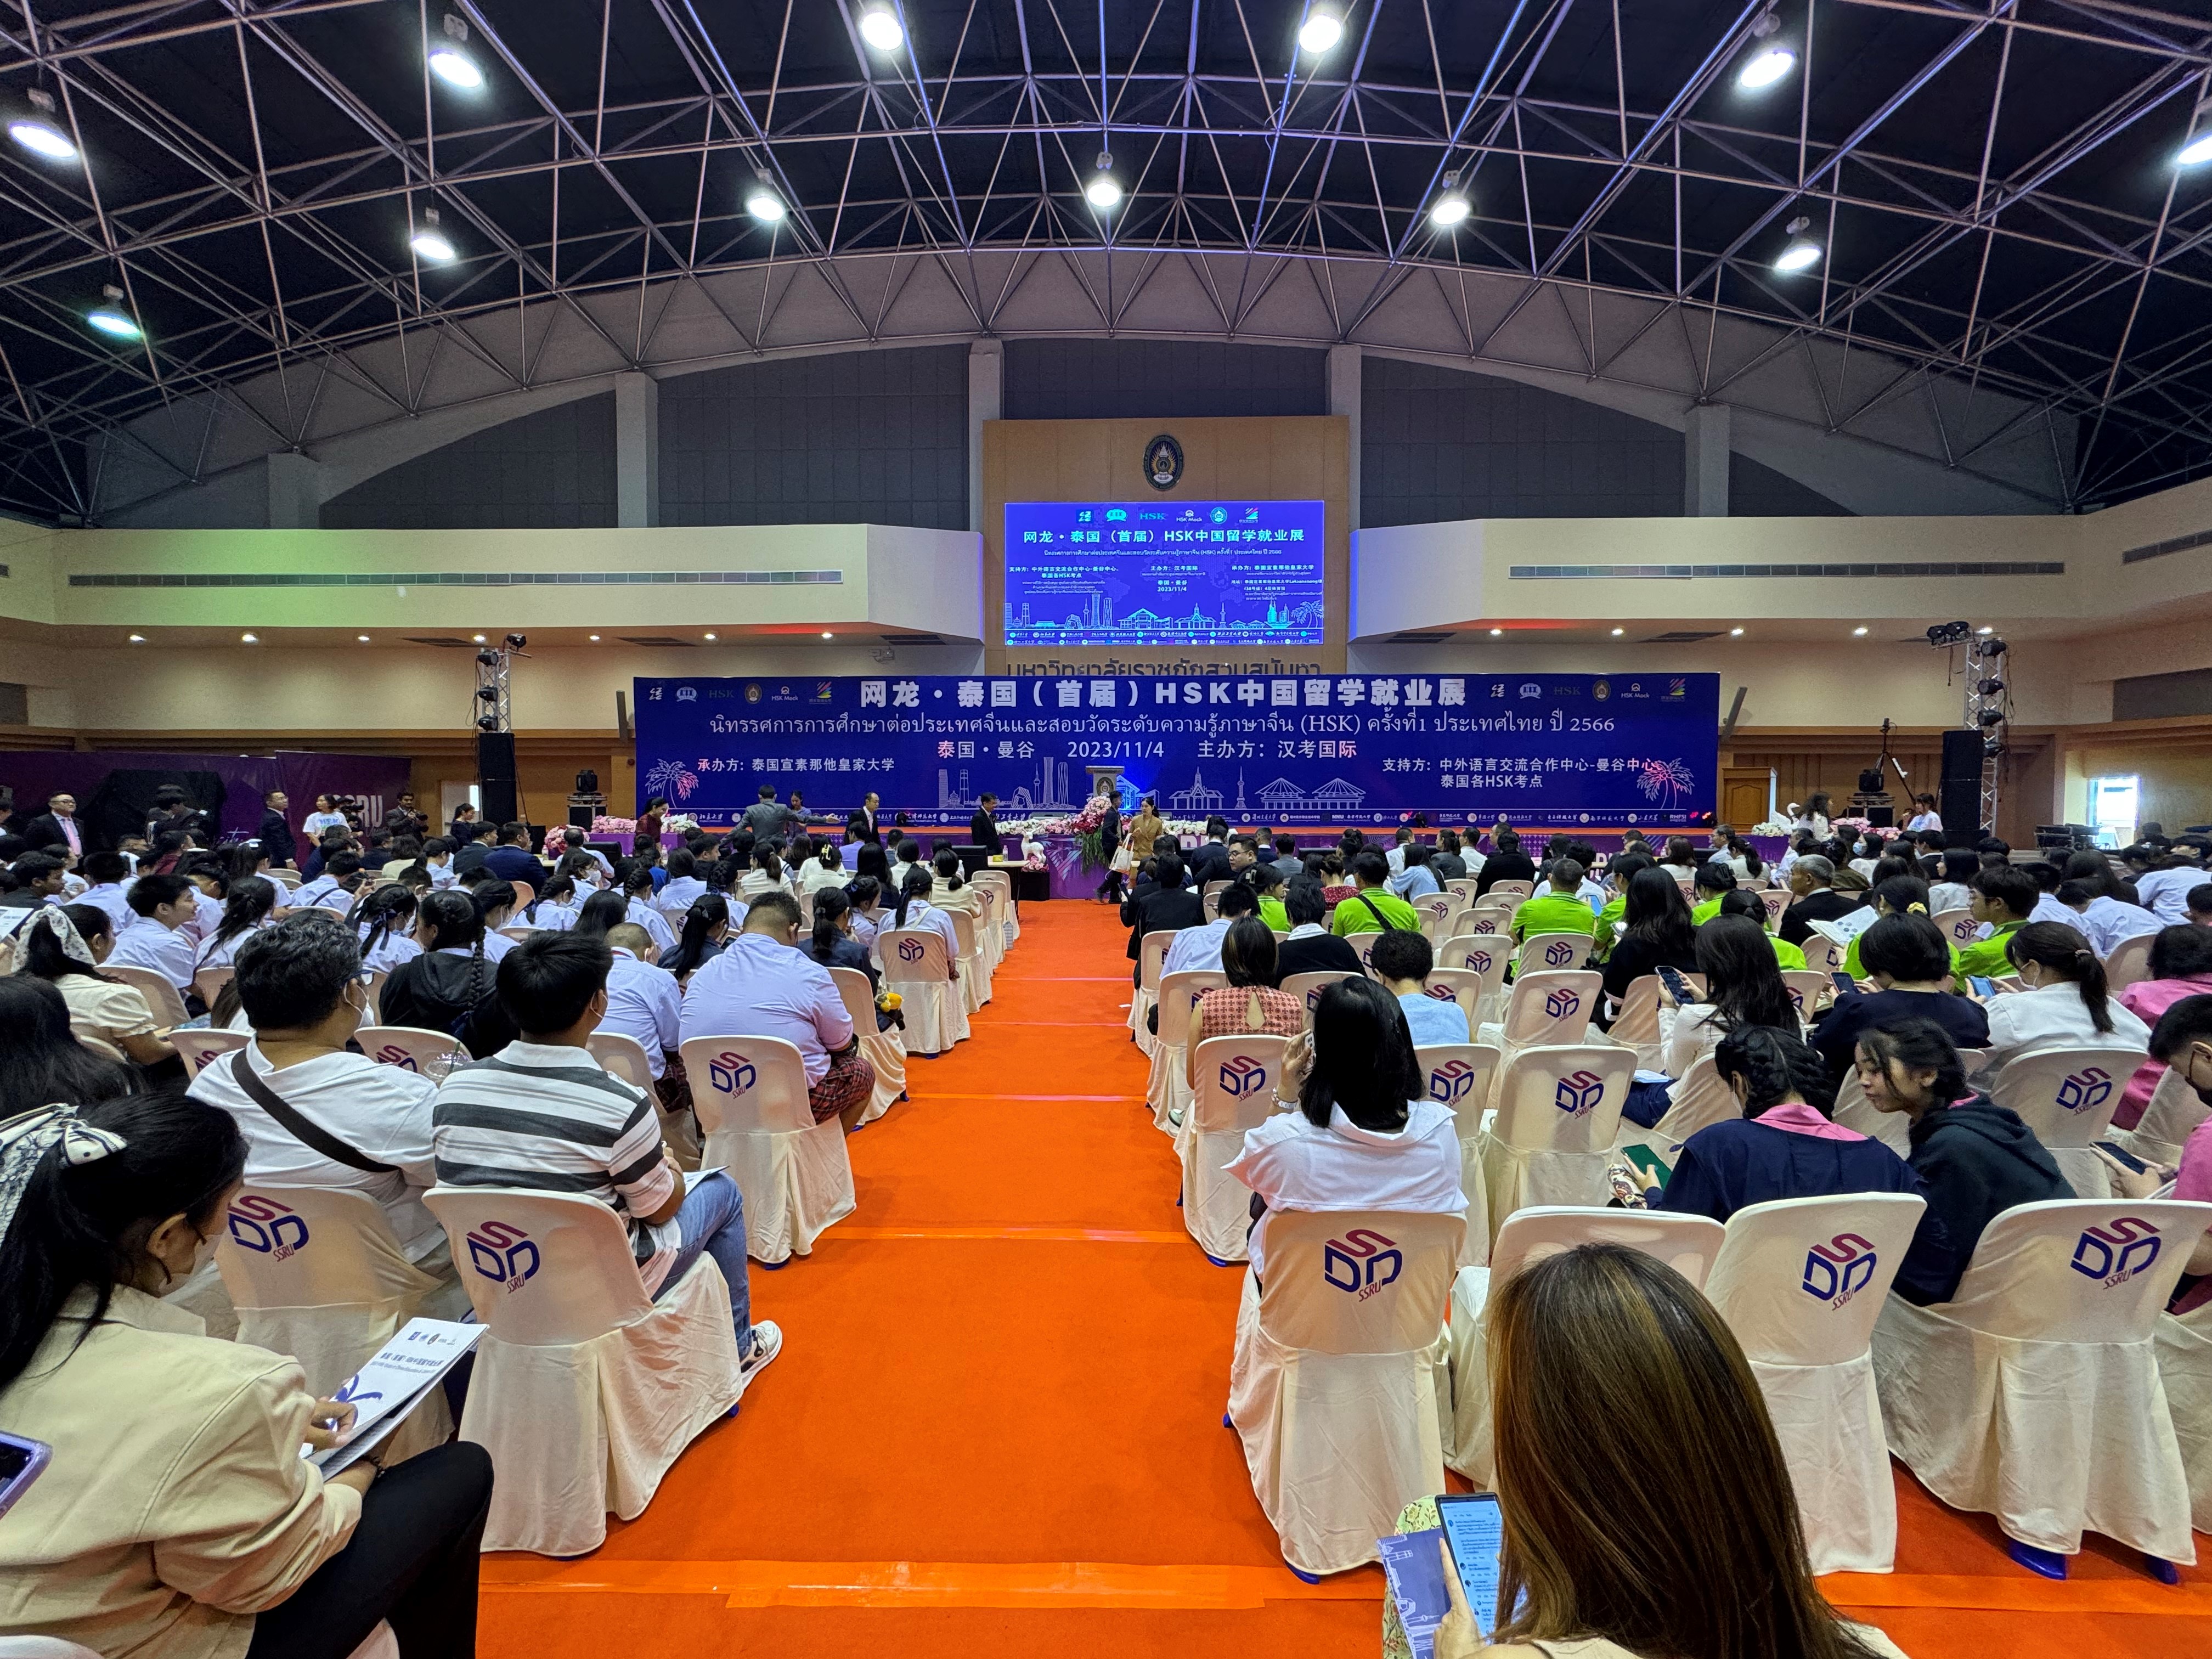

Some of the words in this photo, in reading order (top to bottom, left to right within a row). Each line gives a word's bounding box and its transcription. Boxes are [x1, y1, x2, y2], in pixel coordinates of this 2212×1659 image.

[1301, 714, 1361, 735] (HSK)
[1434, 710, 1543, 731] ประเทศไทย
[1550, 708, 1563, 731] ปี
[1570, 718, 1615, 731] 2566
[1068, 742, 1164, 758] 2023/11/4
[1441, 774, 1542, 788] 泰国各HSK考点
[273, 1243, 295, 1262] SSRU
[507, 1273, 525, 1294] SSRU
[1358, 1279, 1382, 1302] SSRU
[1832, 1286, 1854, 1311] SSRU
